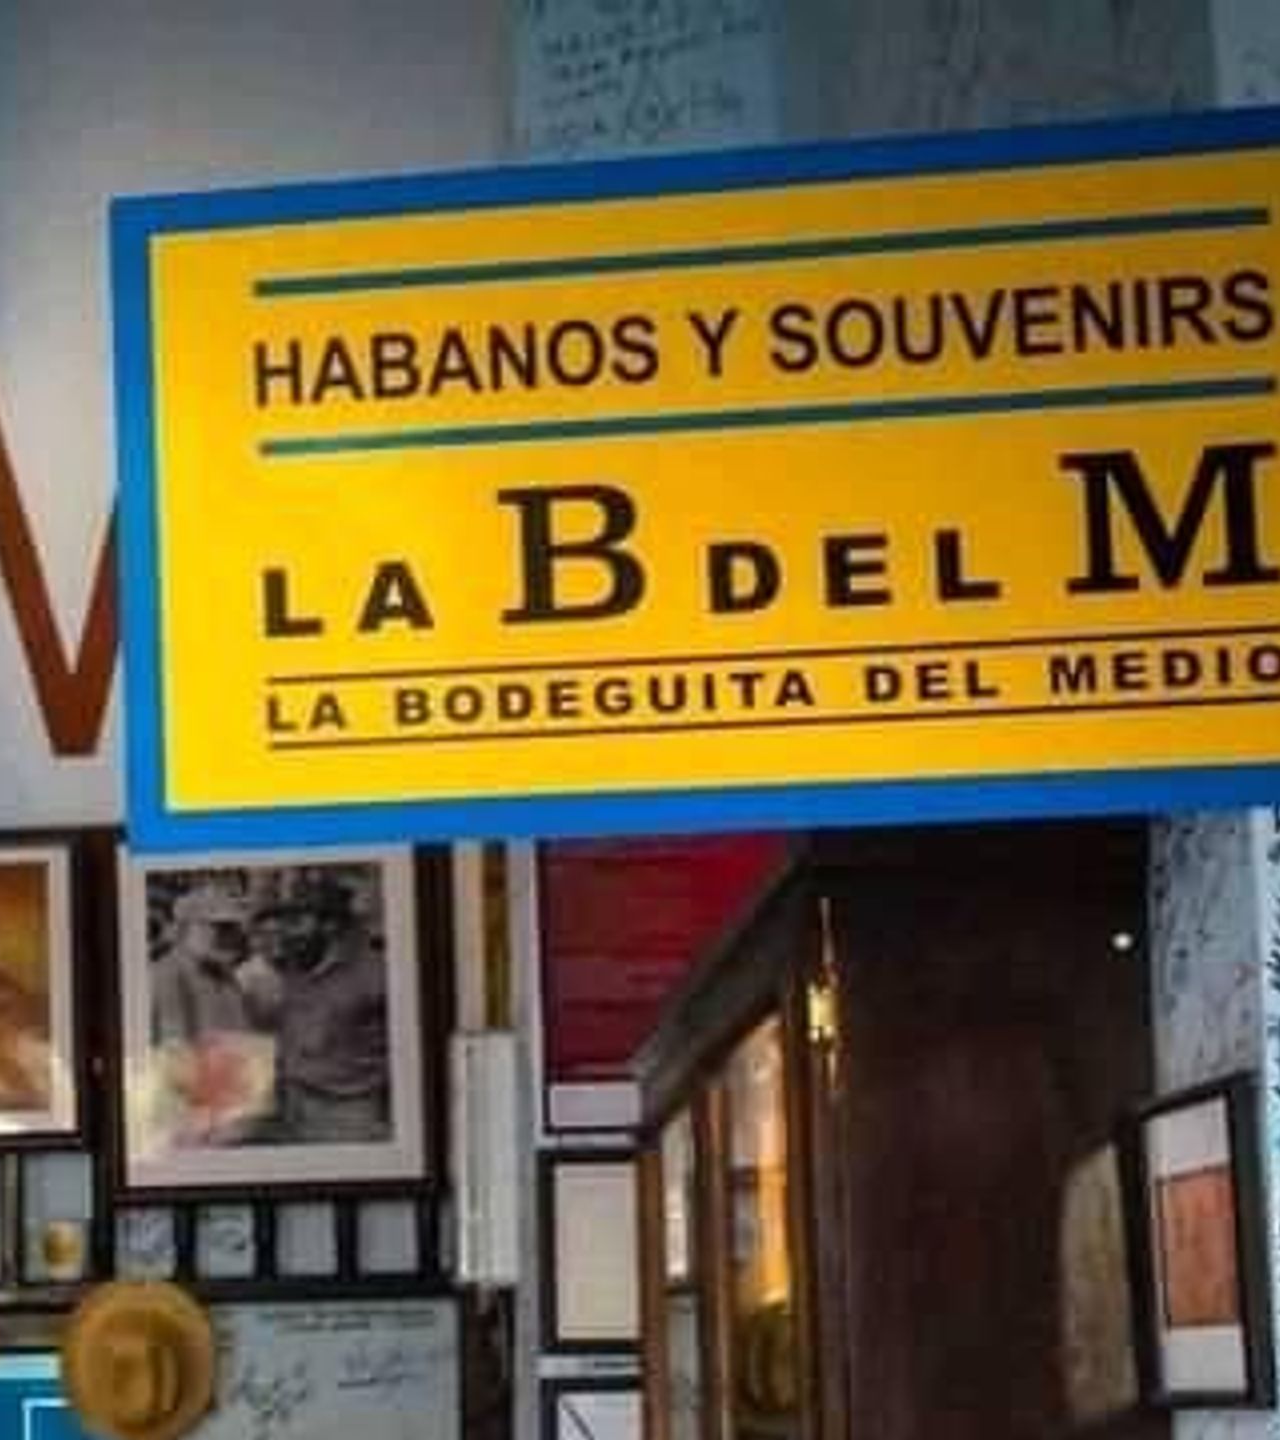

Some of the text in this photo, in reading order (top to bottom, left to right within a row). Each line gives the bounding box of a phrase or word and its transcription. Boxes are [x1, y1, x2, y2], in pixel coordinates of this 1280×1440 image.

[253, 269, 1274, 408] HABANOS Y SOUVENIRS
[260, 441, 1280, 640] LA B DEL M
[265, 643, 1280, 735] LA BODEGUITA DEL MEDIO
